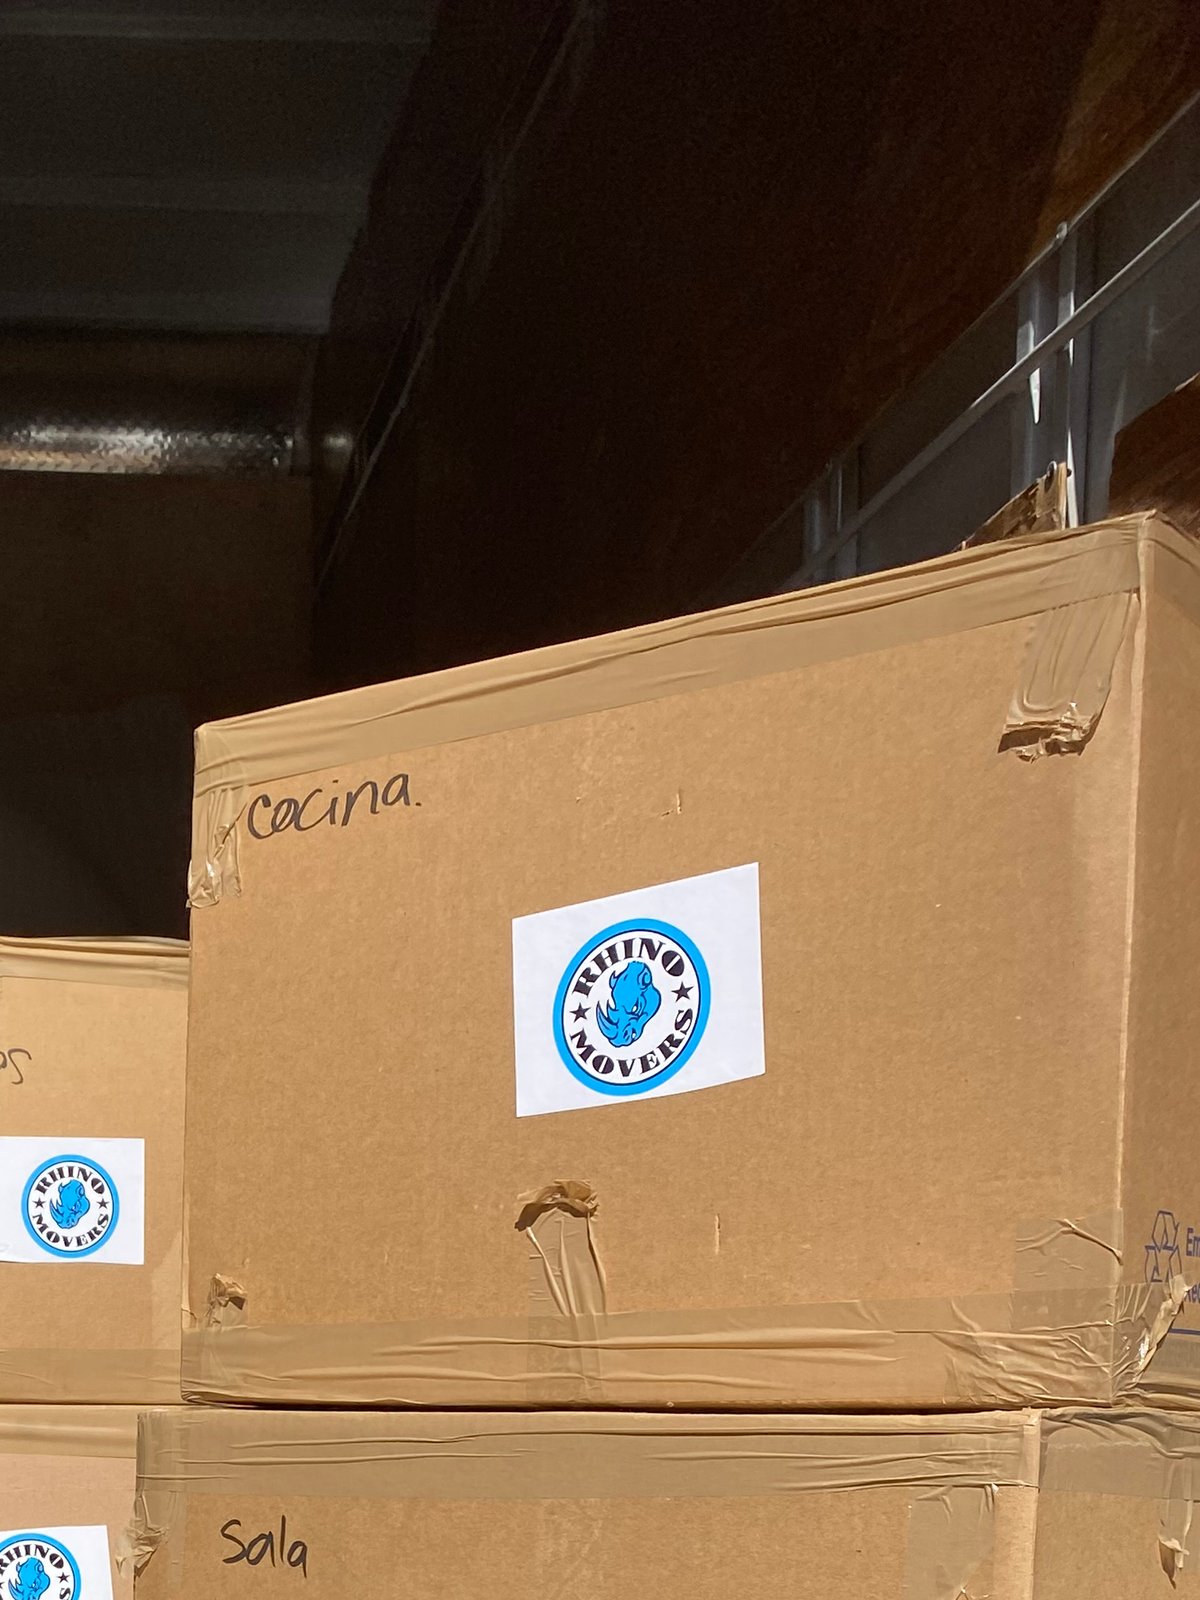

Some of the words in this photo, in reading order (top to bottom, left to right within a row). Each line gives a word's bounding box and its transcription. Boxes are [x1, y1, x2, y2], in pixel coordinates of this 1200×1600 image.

[572, 937, 685, 998] RHINO
[569, 1008, 694, 1078] MOVERS
[34, 1165, 105, 1195] RHINO
[32, 1213, 109, 1247] MOVERS
[220, 1515, 308, 1578] Sala
